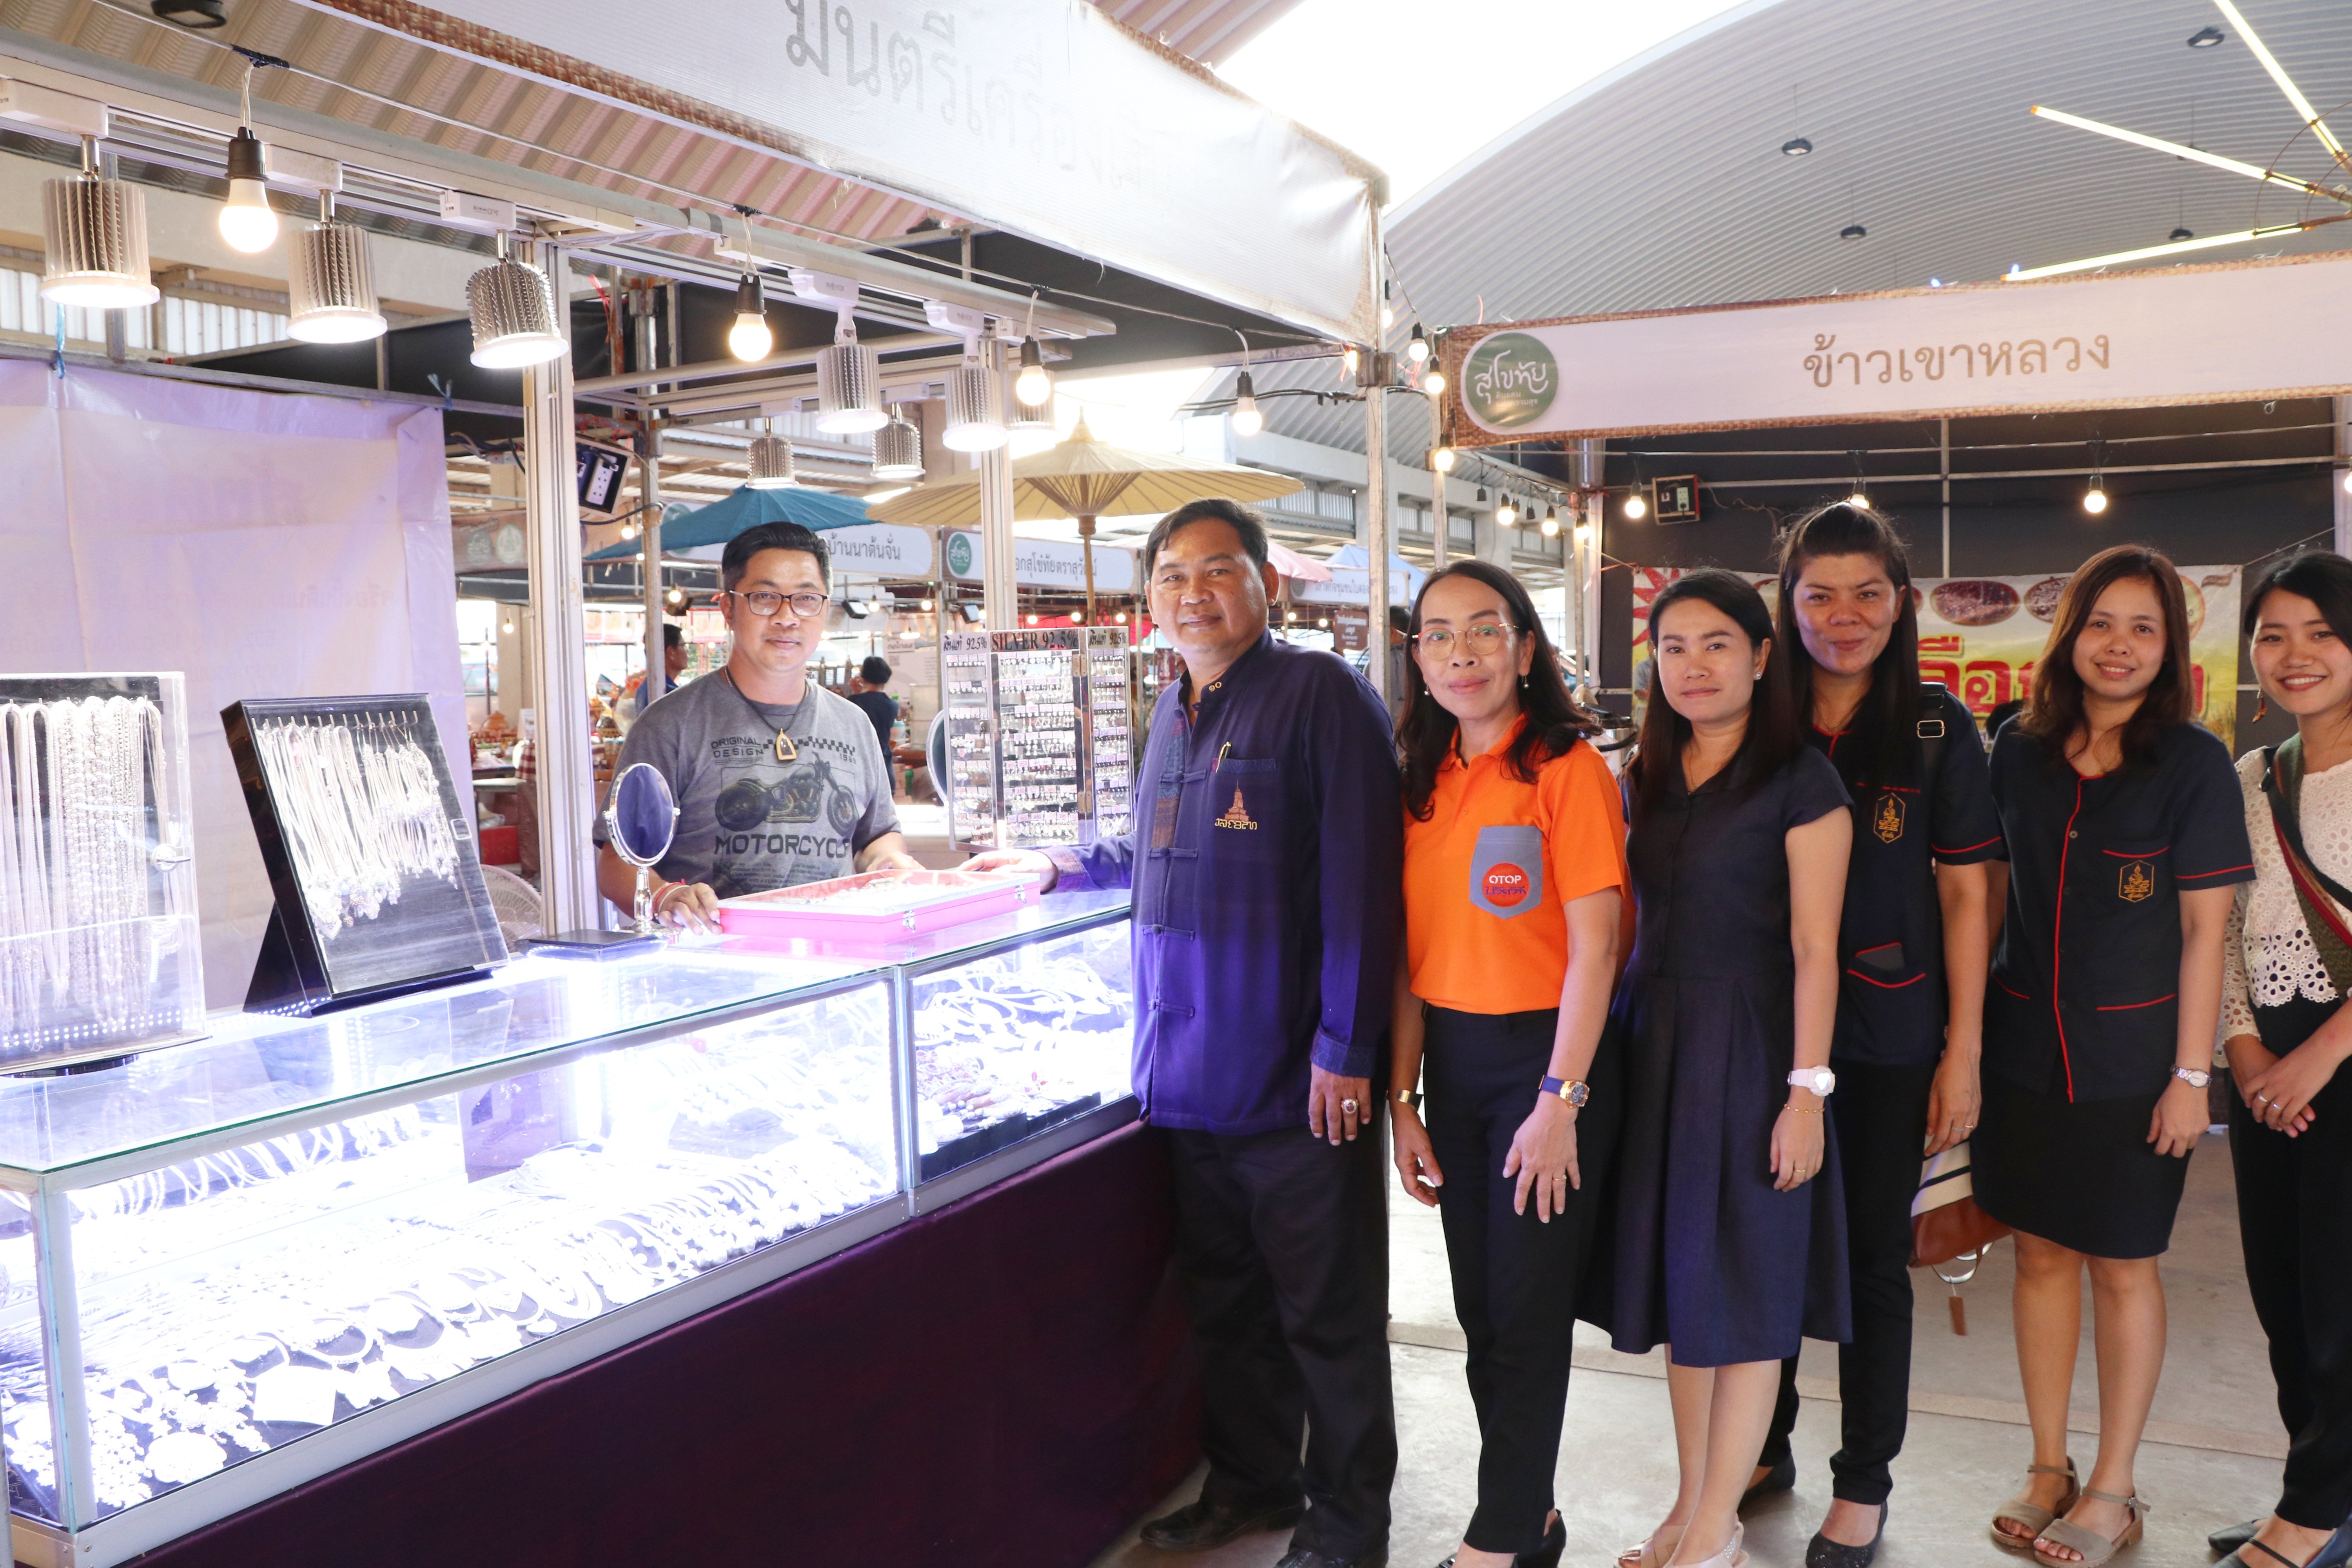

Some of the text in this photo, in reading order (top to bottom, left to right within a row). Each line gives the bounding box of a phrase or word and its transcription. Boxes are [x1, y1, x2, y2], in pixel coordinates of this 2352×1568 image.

[1802, 333, 2111, 388] ข้าวเขาหลวง
[1474, 349, 1549, 405] สุโขทัย
[992, 632, 1039, 651] SILVER
[711, 737, 761, 749] ORIGINAL
[713, 748, 764, 757] DESIGN
[1489, 875, 1522, 884] OTOP
